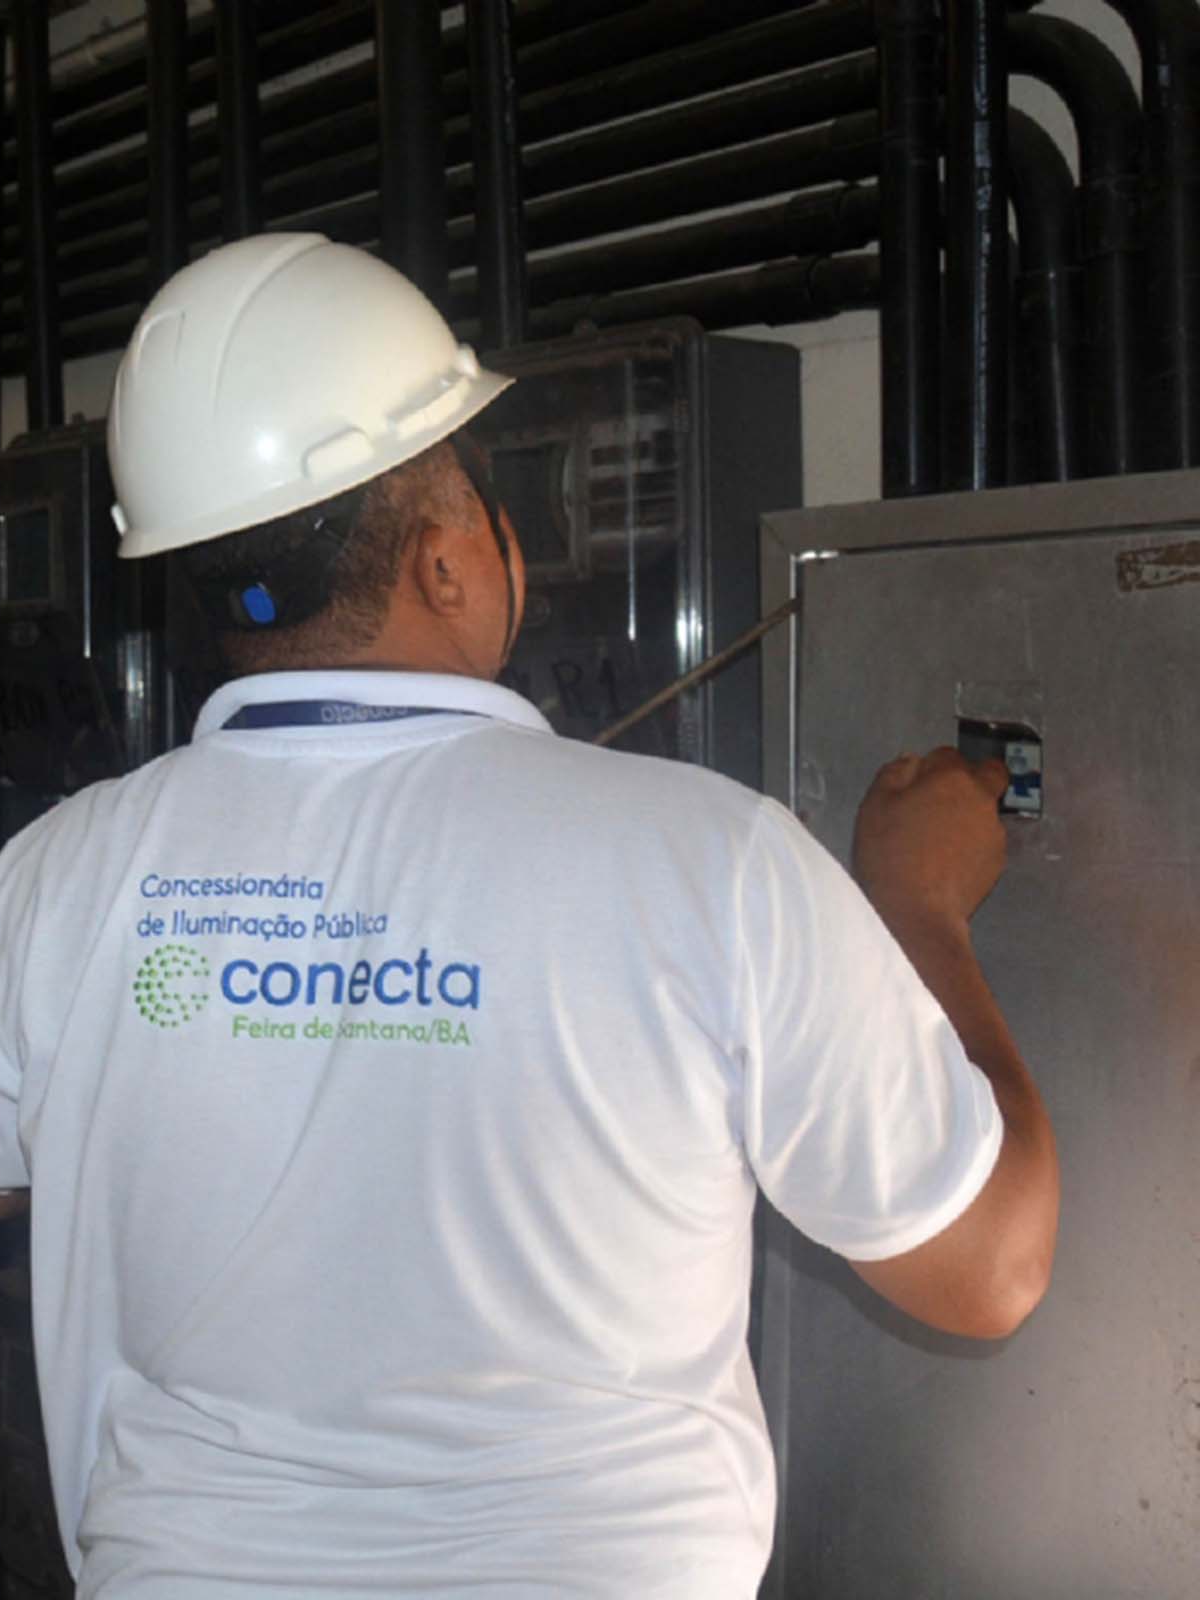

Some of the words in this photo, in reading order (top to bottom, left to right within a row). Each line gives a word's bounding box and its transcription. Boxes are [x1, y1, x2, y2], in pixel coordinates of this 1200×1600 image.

[140, 873, 324, 901] Concessionária
[136, 911, 166, 937] de
[171, 910, 306, 941] Iluminação
[220, 947, 481, 1010] conecta
[231, 1015, 296, 1040] Feira
[303, 1015, 334, 1040] de
